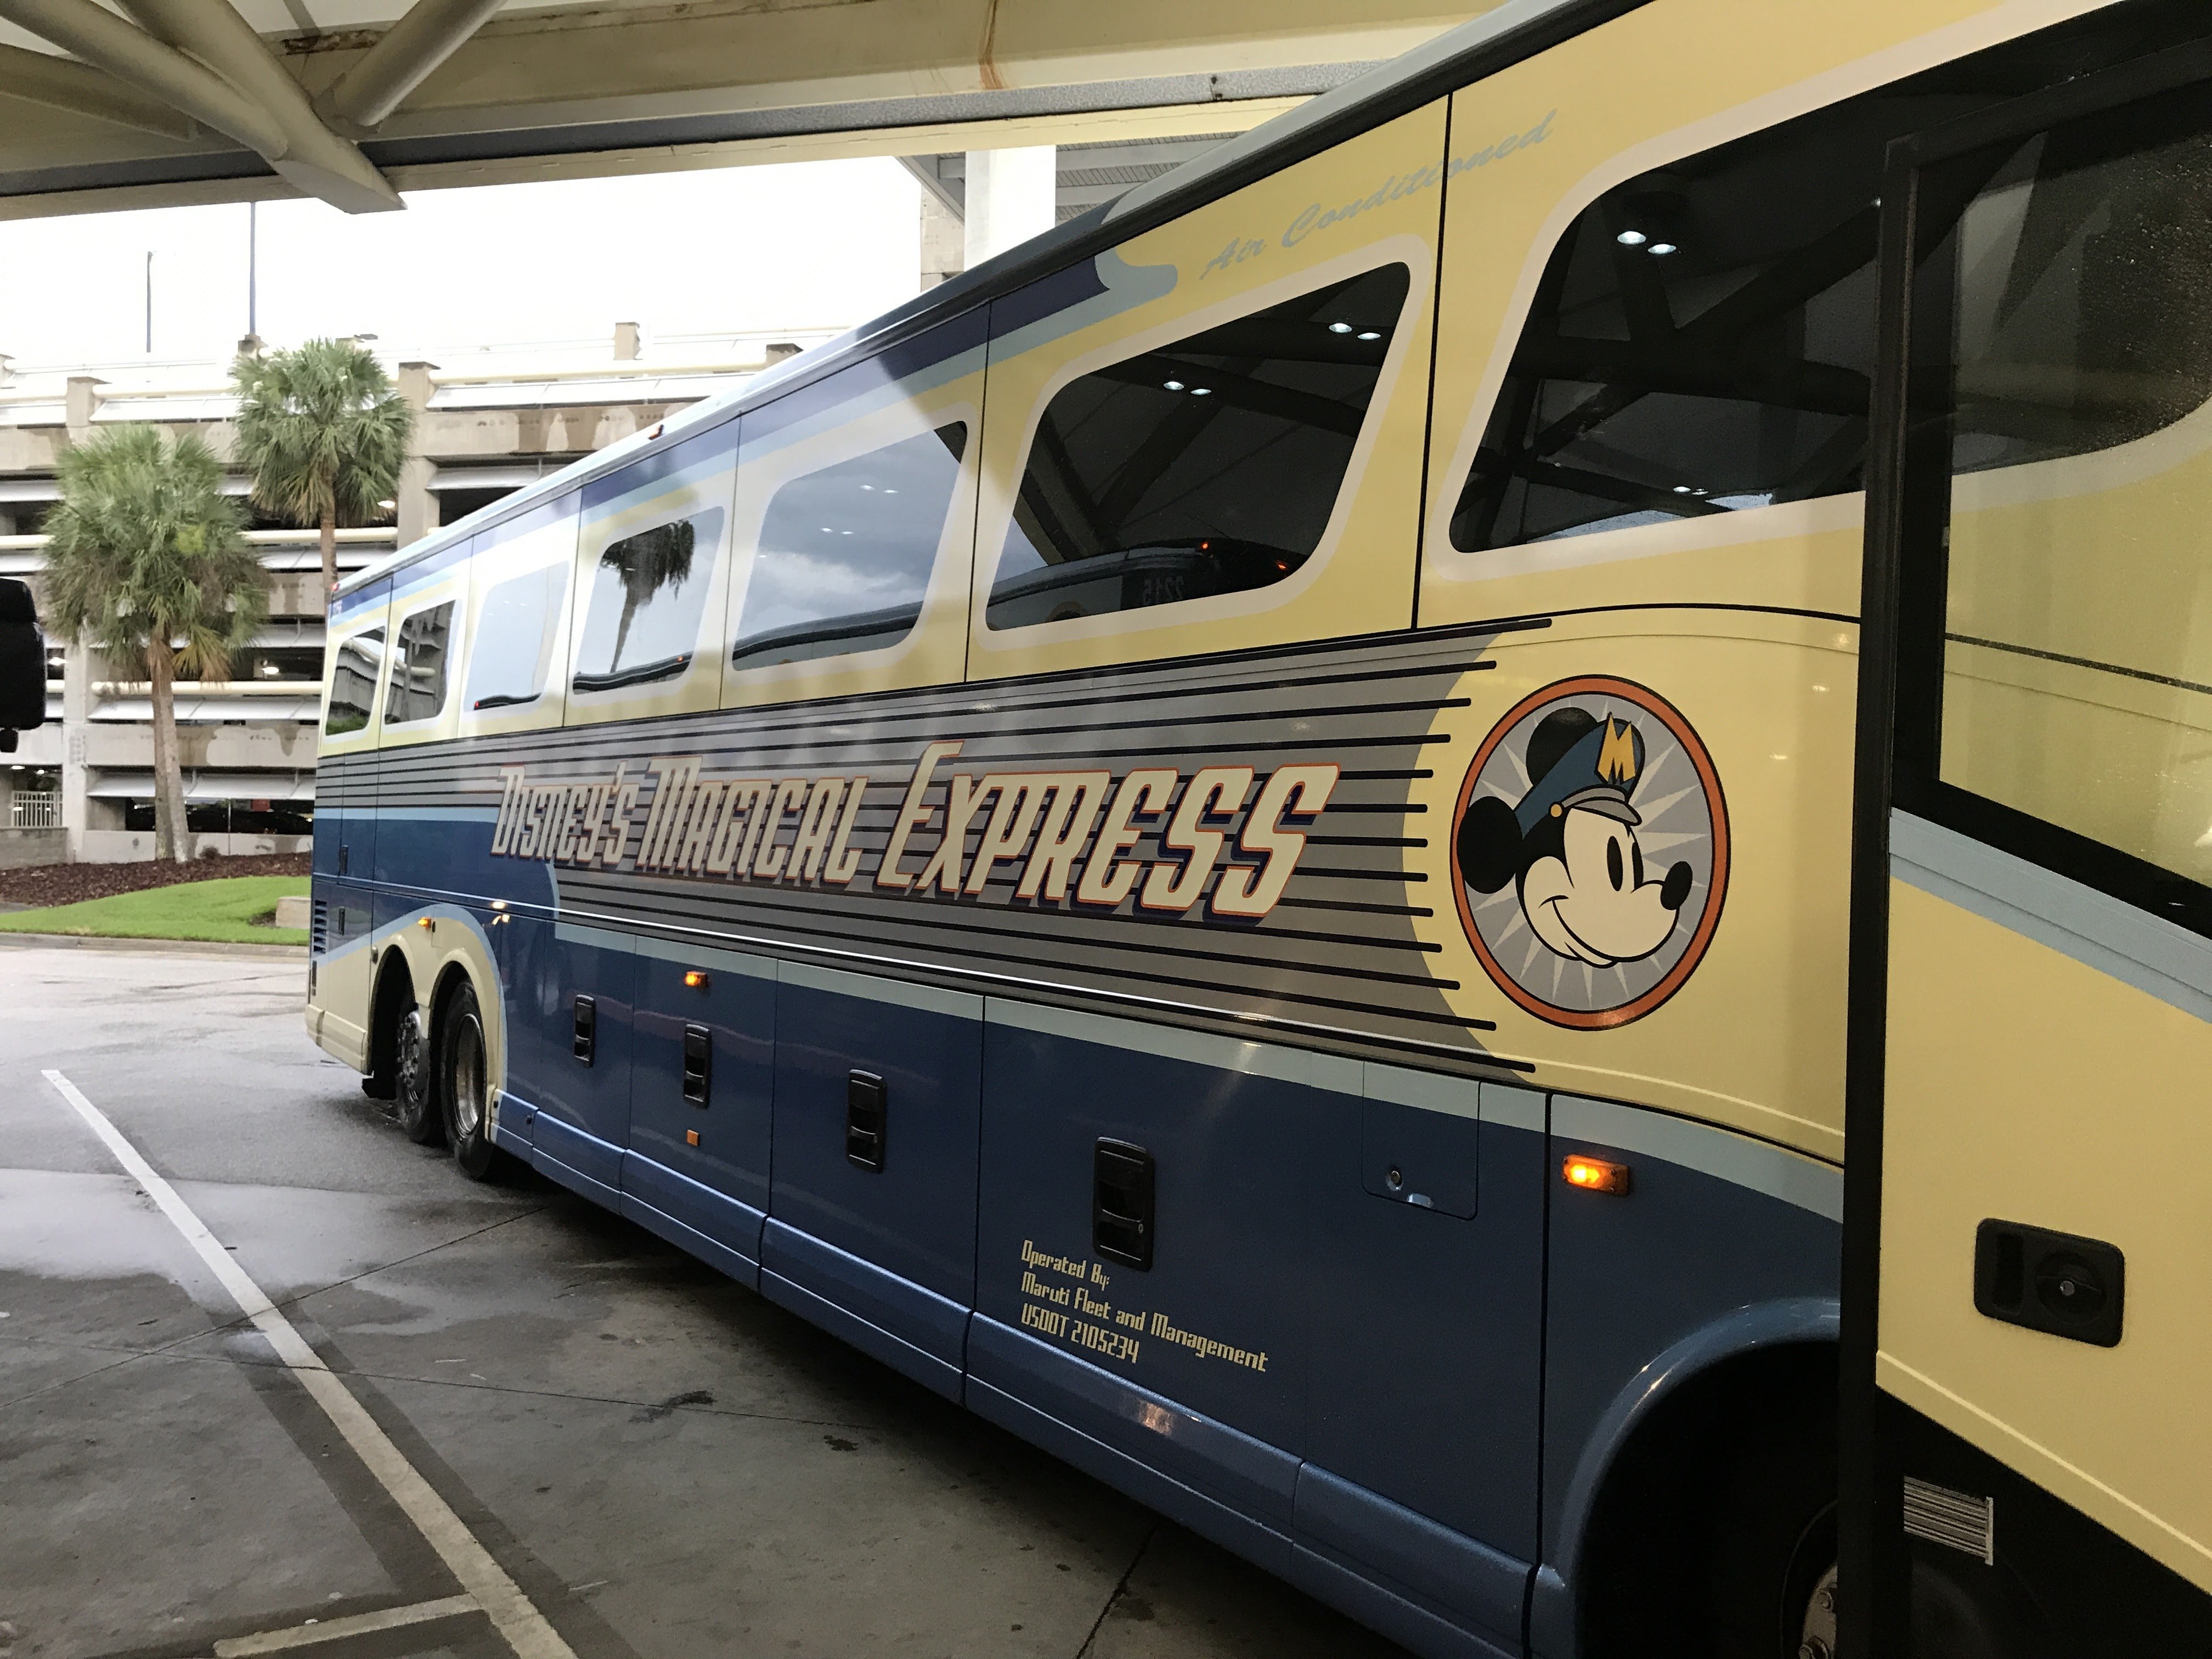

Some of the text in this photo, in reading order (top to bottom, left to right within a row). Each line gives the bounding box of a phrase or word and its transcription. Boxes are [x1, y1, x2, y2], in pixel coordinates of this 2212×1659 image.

[1199, 108, 1558, 280] Air Conditioned
[635, 755, 870, 884] MAGICAL
[876, 738, 1341, 923] EXPRESS
[1022, 1239, 1109, 1291] Operated By:
[1022, 1271, 1268, 1372] Maruti Fleet and Management
[1022, 1303, 1139, 1363] USDOT 2105234
